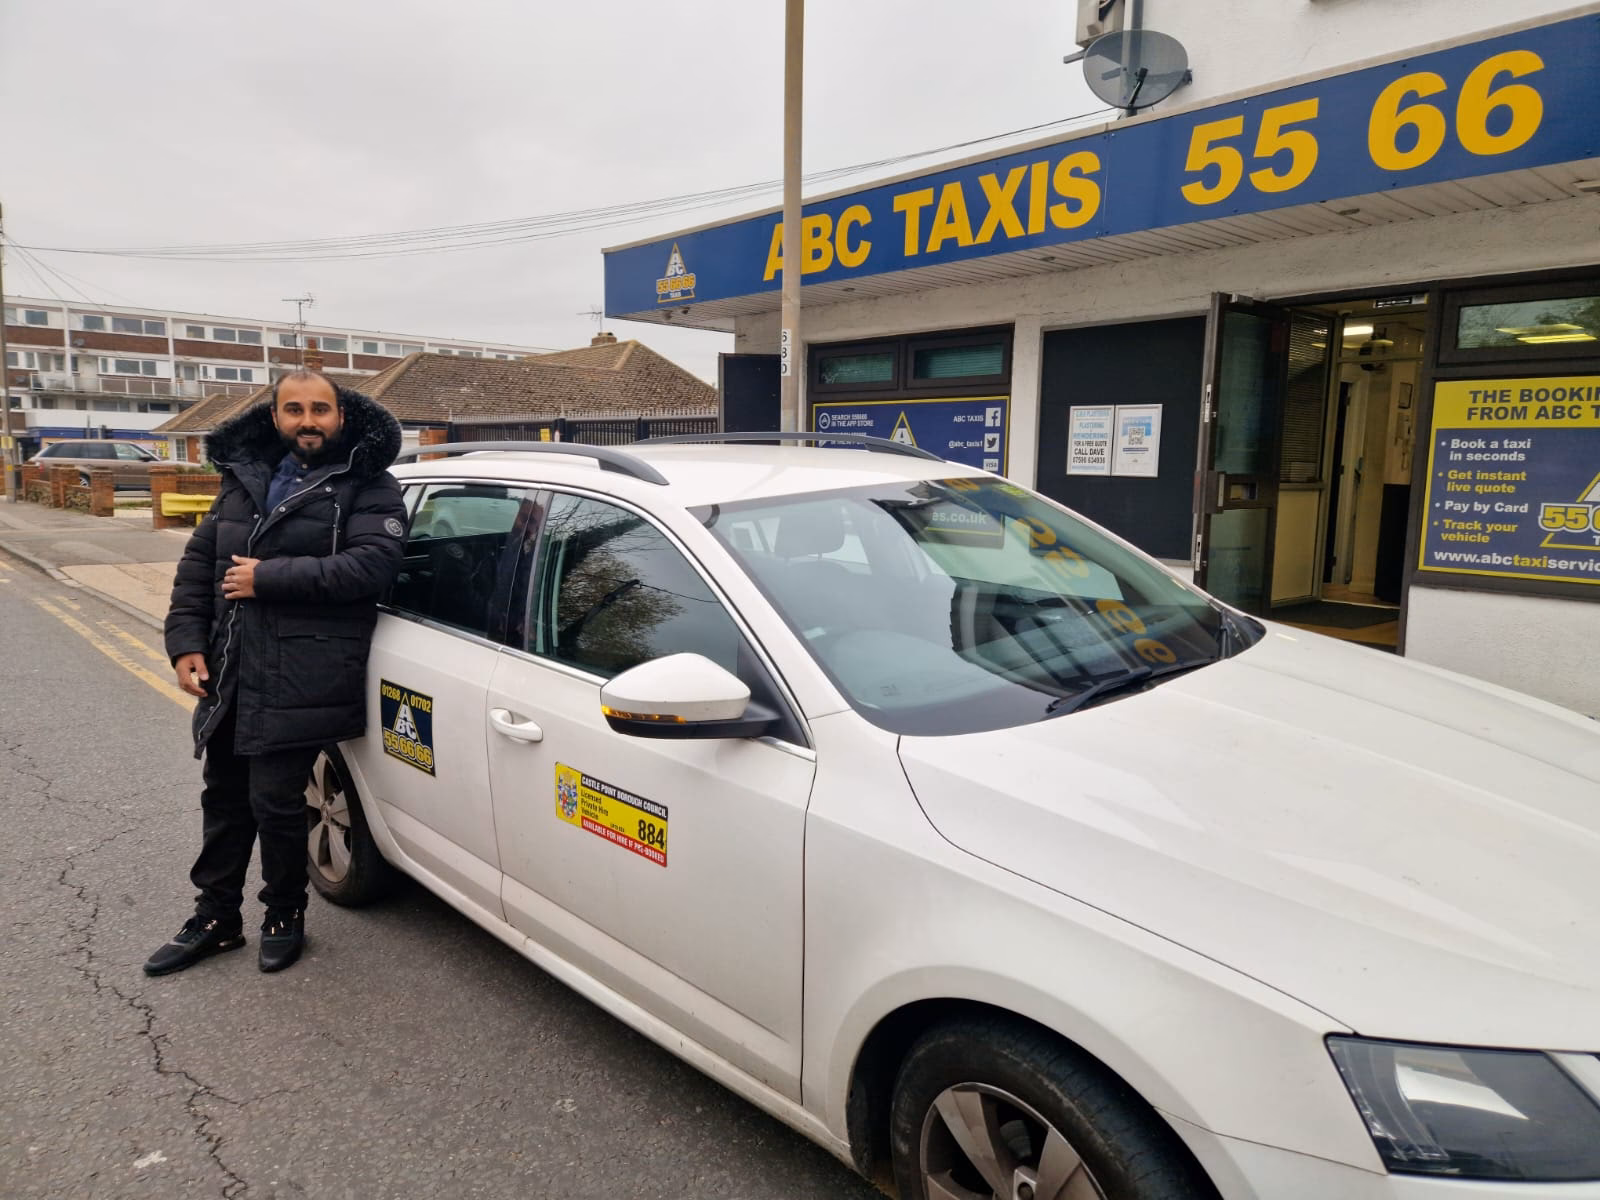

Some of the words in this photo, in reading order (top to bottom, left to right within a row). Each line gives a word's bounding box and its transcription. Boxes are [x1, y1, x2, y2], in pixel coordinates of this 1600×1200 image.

[763, 205, 872, 281] ABC
[893, 151, 1101, 256] TAXIS
[1180, 97, 1319, 205] 55
[1367, 49, 1544, 171] 66
[1469, 390, 1512, 404] THE
[1467, 405, 1528, 421] FROM
[1535, 404, 1582, 420] ABC
[1450, 438, 1487, 448] Book
[1489, 440, 1499, 448] a
[1503, 438, 1531, 448] taxi
[1074, 448, 1088, 456] CALL
[1089, 448, 1104, 456] DAVE
[1449, 450, 1462, 461] in
[1466, 451, 1526, 461] seconds
[1447, 470, 1472, 480] Get
[1476, 470, 1526, 481] instant
[1447, 481, 1471, 492] live
[1475, 483, 1516, 494] quote
[1445, 500, 1470, 513] Pay
[1473, 501, 1490, 514] by
[1494, 502, 1528, 513] Card
[1443, 519, 1482, 531] Track
[1486, 523, 1518, 533] your
[1441, 532, 1490, 543] vehicle
[382, 684, 400, 701] 01268
[411, 694, 431, 713] 01702
[581, 789, 602, 804] Licensed
[582, 776, 601, 791] CASTLE
[601, 784, 616, 797] POINT
[617, 790, 643, 808] BOROUGH
[643, 801, 667, 818] COUNCIL
[581, 798, 597, 812] Private
[599, 805, 608, 816] Hire
[638, 819, 665, 849] 884
[583, 819, 606, 836] AVAILABLE
[607, 828, 617, 841] FOR
[617, 834, 628, 846] HIRE
[628, 840, 633, 848] IF
[634, 843, 665, 864] PRE-BOOKED
